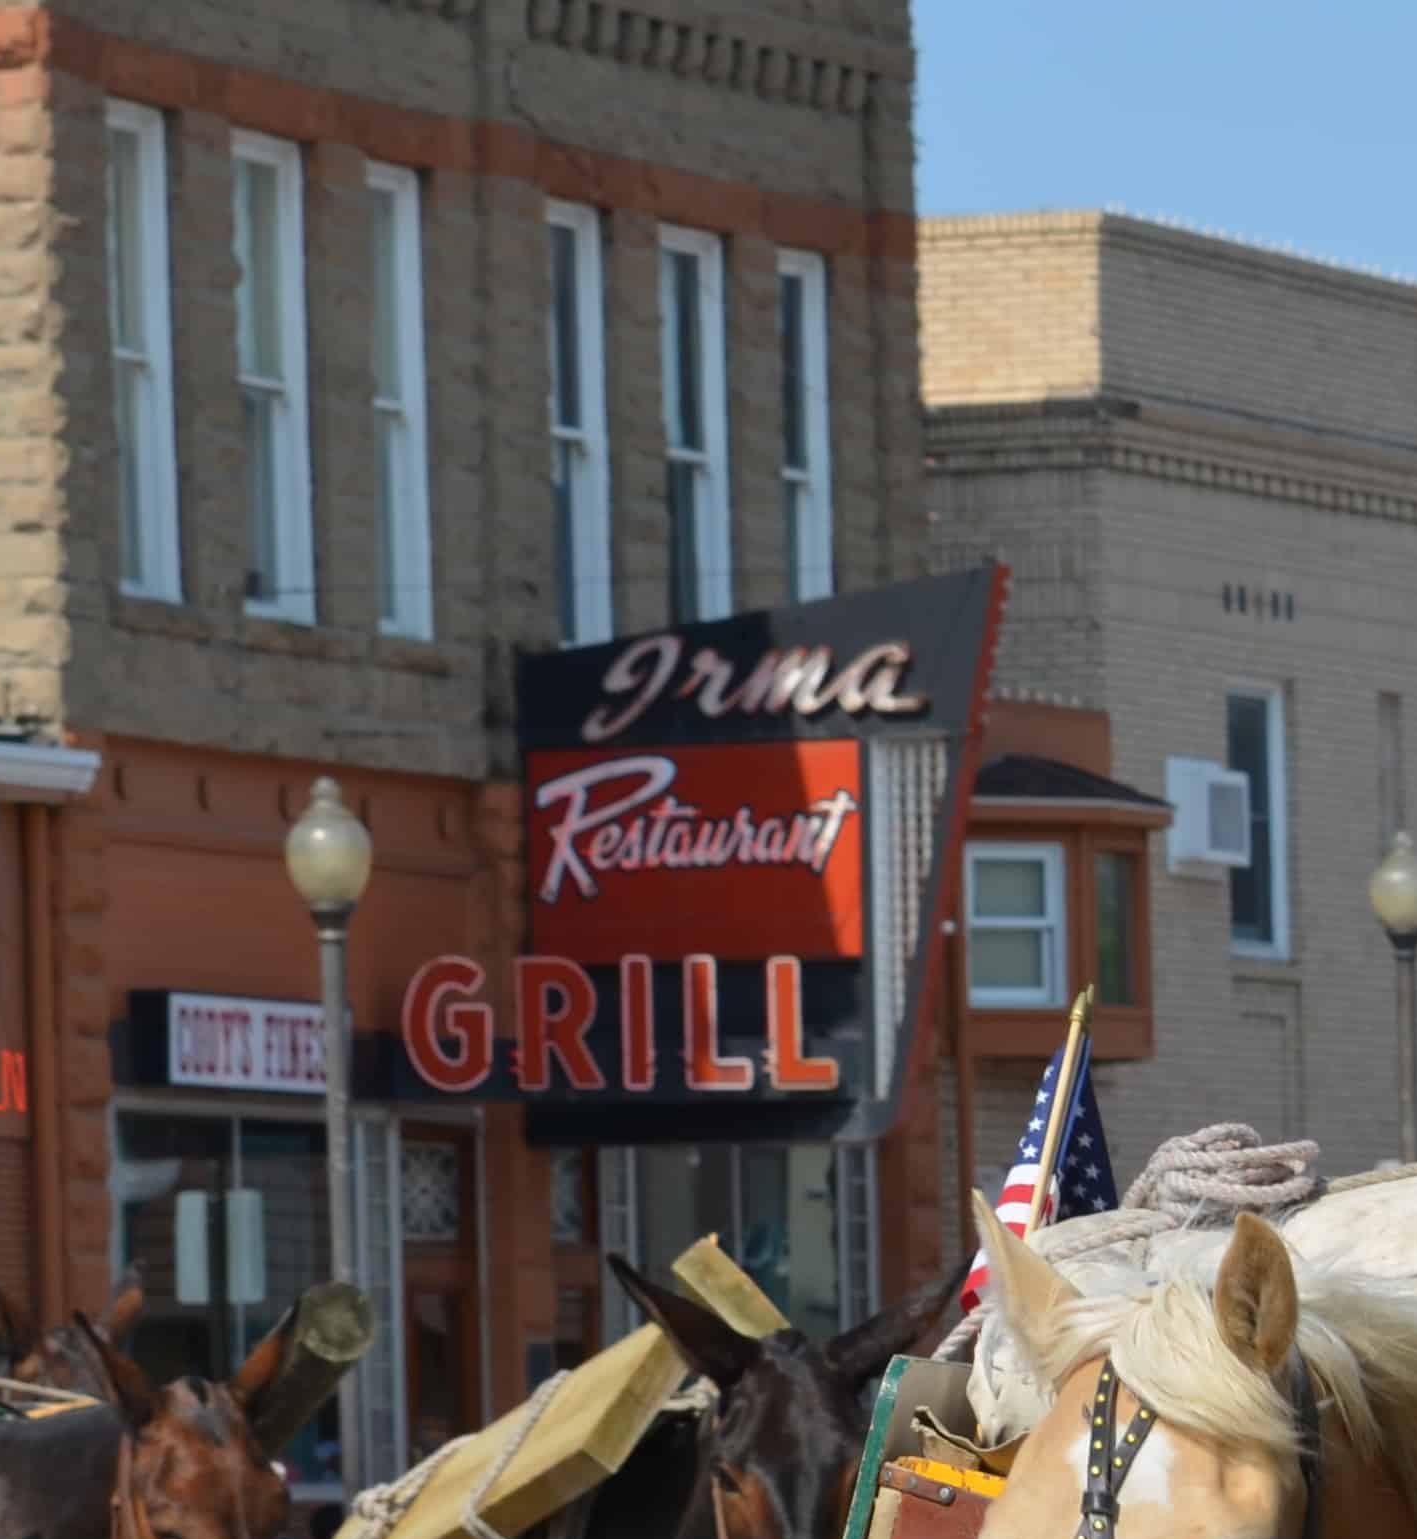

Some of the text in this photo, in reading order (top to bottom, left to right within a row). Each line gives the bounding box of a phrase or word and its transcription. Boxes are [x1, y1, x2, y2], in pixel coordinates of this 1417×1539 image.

[581, 635, 926, 742] Irma
[536, 755, 857, 904] Restaurant
[401, 954, 839, 1092] GRILL
